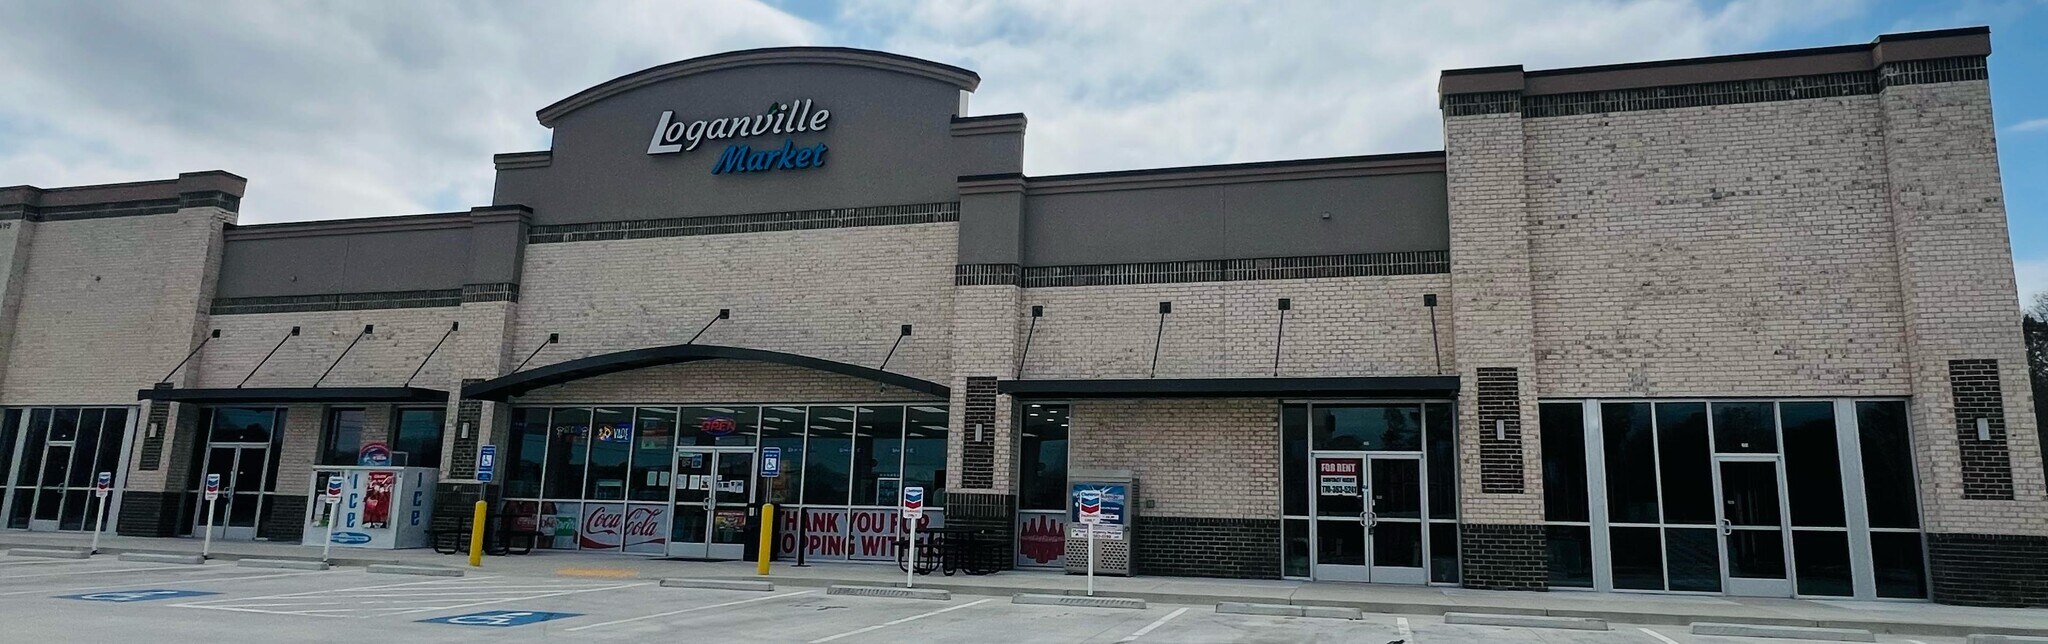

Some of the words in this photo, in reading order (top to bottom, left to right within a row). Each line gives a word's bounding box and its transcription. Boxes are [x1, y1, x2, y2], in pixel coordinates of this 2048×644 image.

[647, 98, 830, 155] Loganville
[711, 138, 829, 176] Market
[1320, 463, 1336, 472] FOR
[1336, 463, 1356, 473] RENT
[844, 511, 886, 534] YOU
